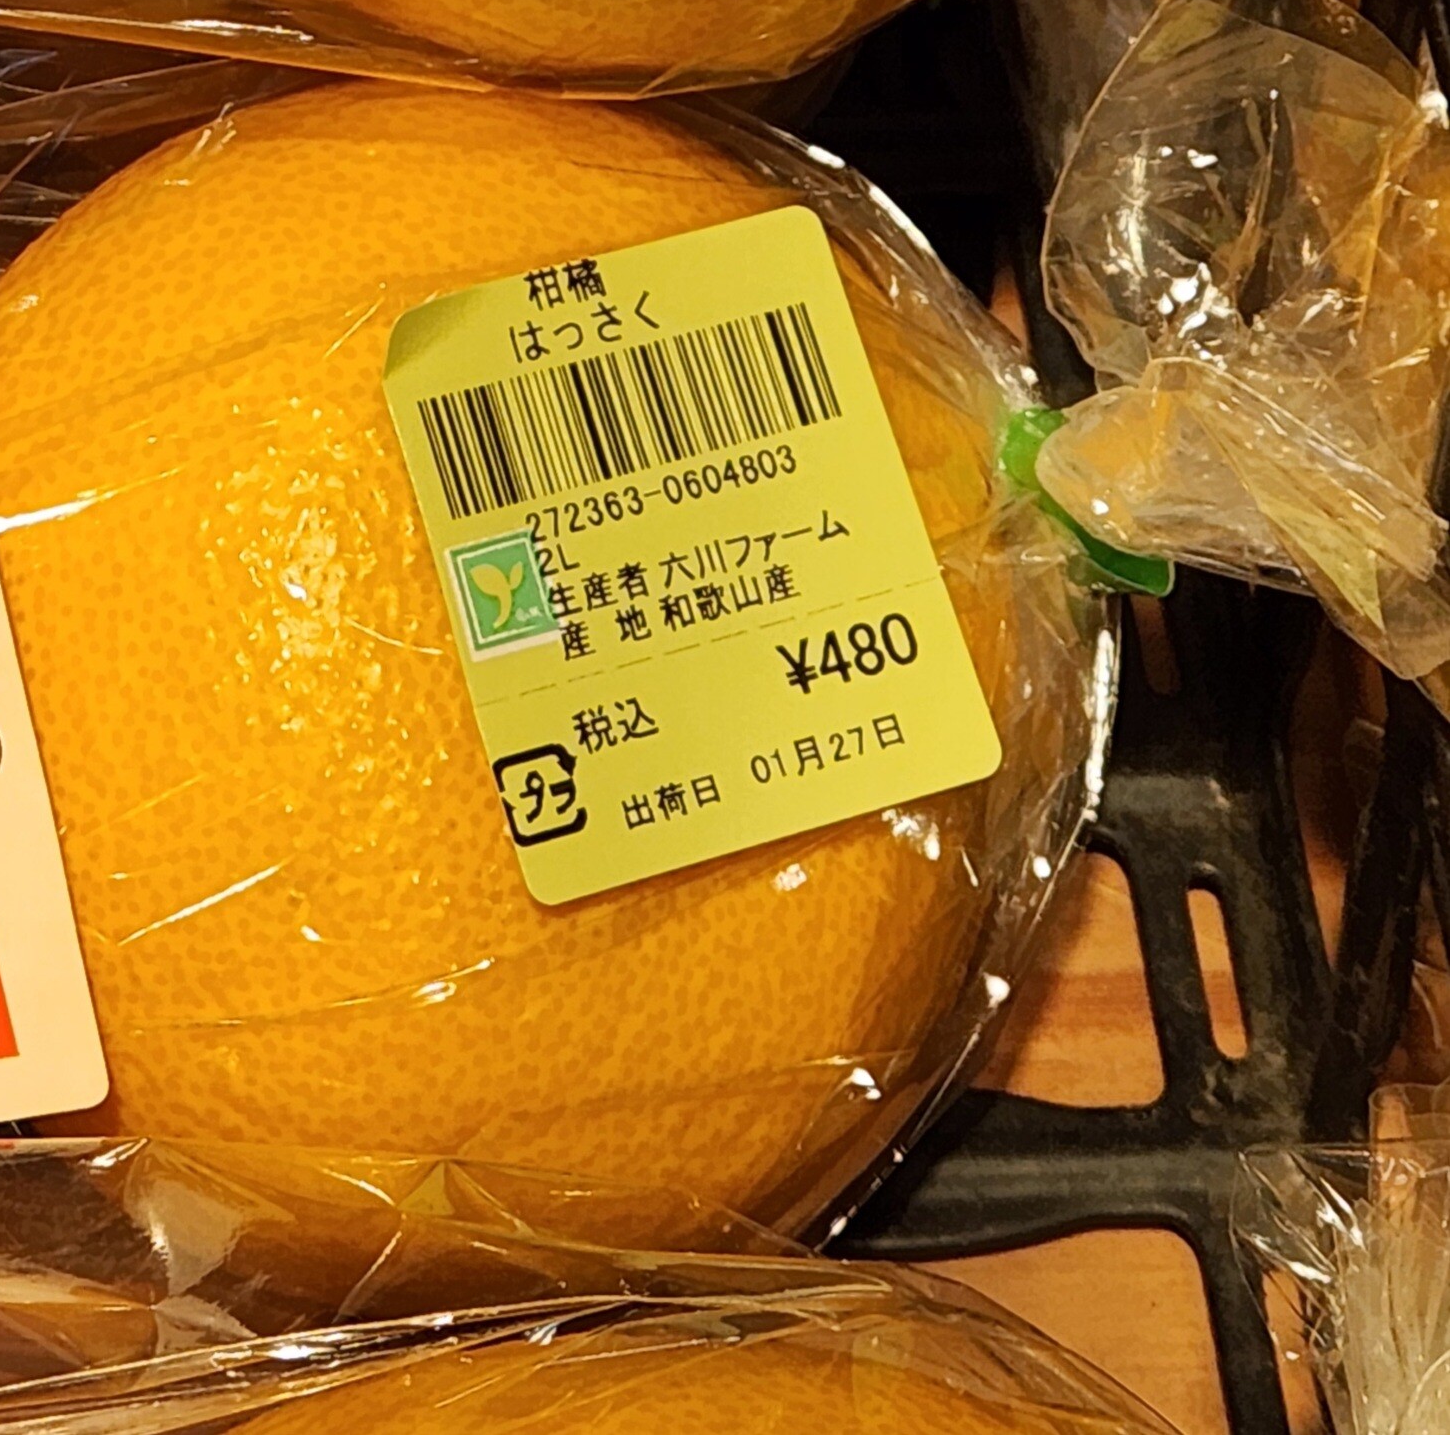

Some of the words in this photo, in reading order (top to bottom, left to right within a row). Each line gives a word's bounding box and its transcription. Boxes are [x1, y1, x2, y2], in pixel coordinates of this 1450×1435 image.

[524, 257, 607, 311] 柑橘
[509, 290, 661, 364] はっさく
[524, 444, 798, 544] 272363-0604803
[535, 543, 581, 578] 2L
[548, 561, 649, 619] 生産者
[658, 509, 849, 591] 六川ファーム
[660, 563, 802, 633] 和歌山産
[775, 612, 919, 695] ¥480
[573, 695, 660, 755] 税込
[622, 774, 722, 831] 出荷日
[750, 712, 906, 785] 01月27日
